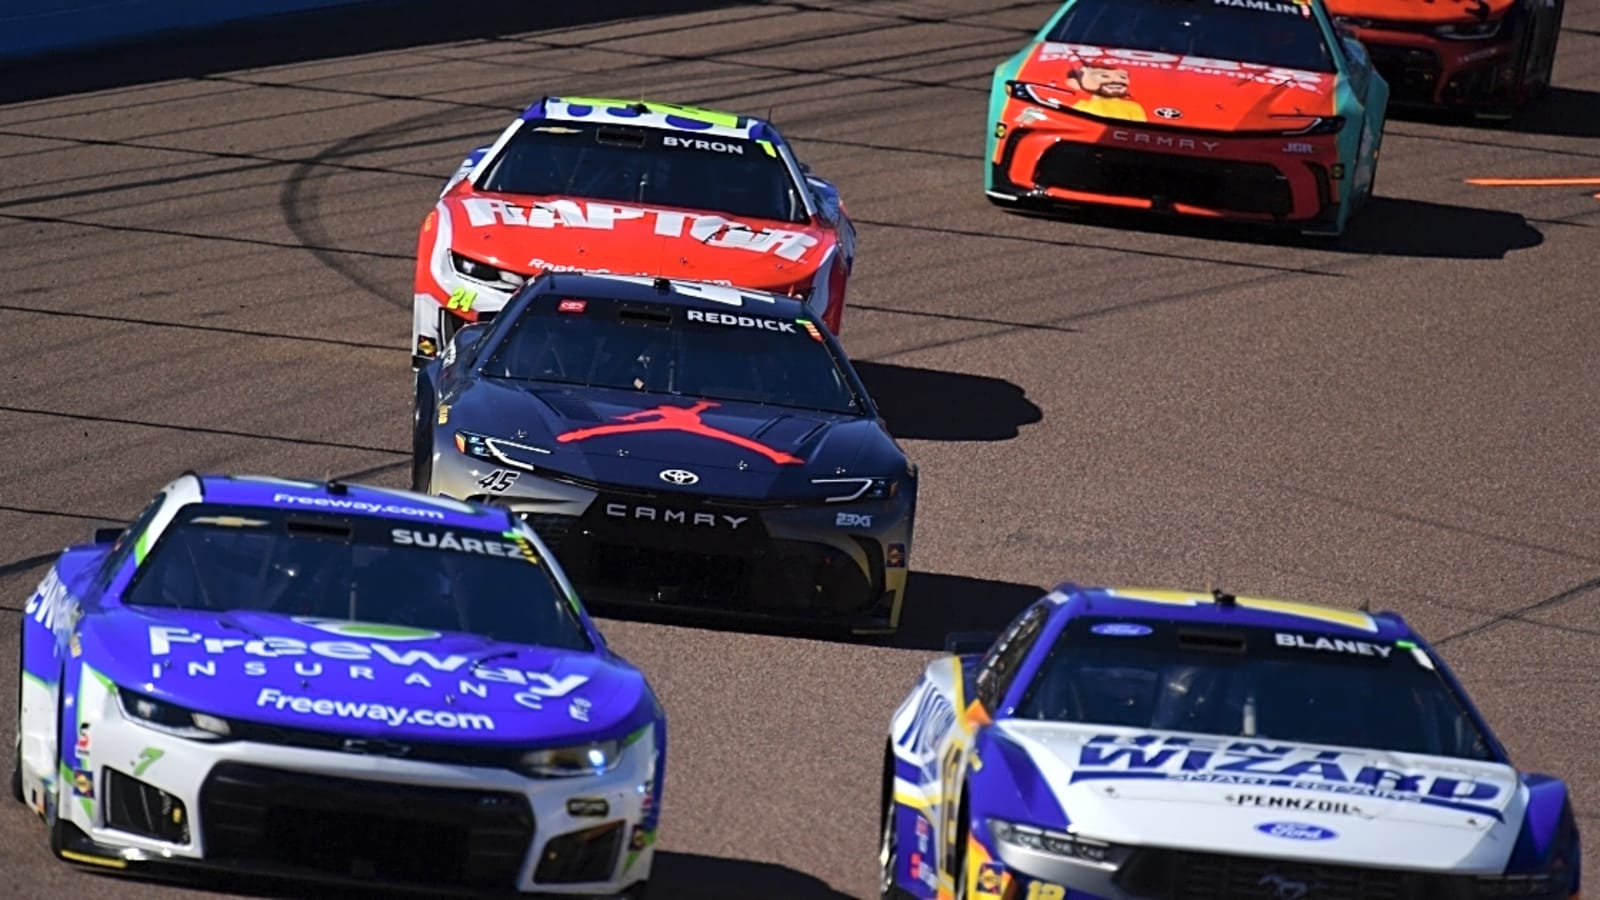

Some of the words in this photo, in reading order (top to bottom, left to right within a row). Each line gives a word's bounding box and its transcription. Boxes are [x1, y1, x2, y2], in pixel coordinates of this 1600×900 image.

[663, 136, 744, 155] BYRON
[1113, 130, 1219, 151] CAMRY
[461, 199, 819, 262] RAPTOR
[447, 287, 478, 312] 24
[687, 309, 797, 334] REDDICK
[478, 469, 520, 493] 45
[274, 493, 444, 520] Freeway.com
[606, 503, 748, 529] CAMRY
[391, 528, 527, 561] SUÁREZ
[1275, 633, 1392, 659] BLANEY
[148, 625, 589, 697] Freeway
[256, 688, 495, 730] Freeway.com
[134, 746, 165, 776] 7
[1078, 744, 1501, 801] WIZARD
[1238, 794, 1353, 816] PENNZOIL
[1268, 822, 1326, 842] Ford
